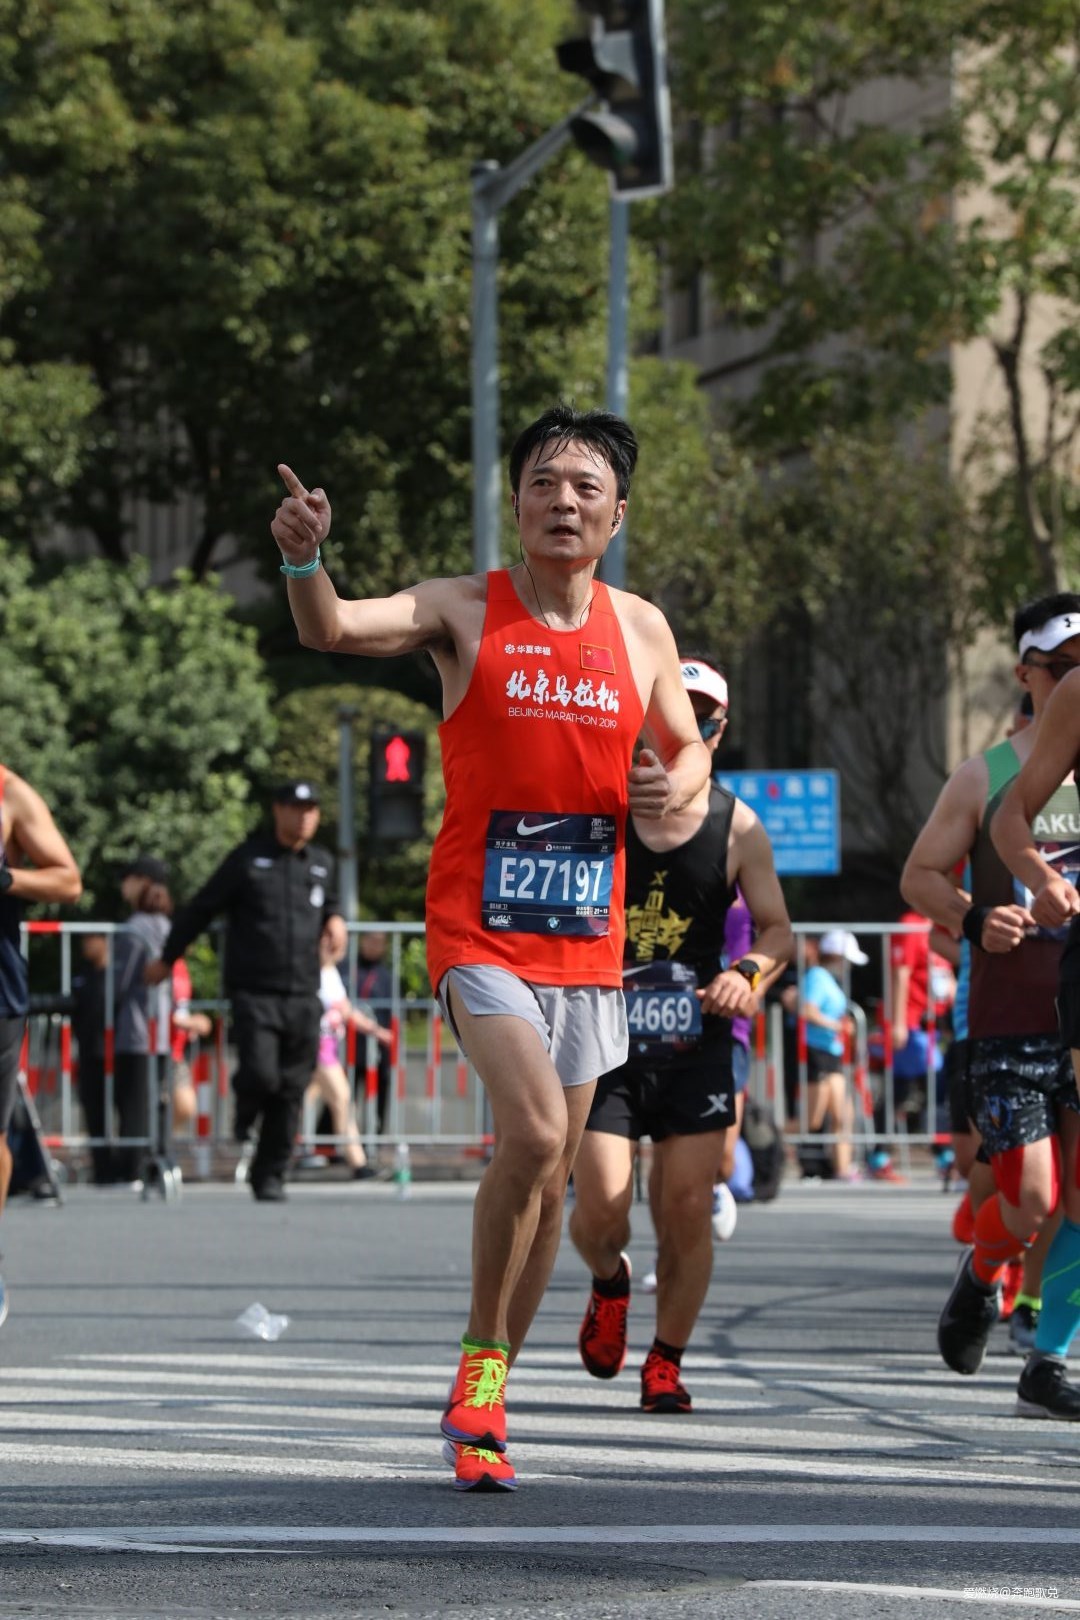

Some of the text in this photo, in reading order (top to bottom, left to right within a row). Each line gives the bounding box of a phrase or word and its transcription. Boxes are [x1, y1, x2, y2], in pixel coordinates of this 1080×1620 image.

[516, 644, 551, 656] 华夏幸福
[506, 669, 619, 714] 北京马拉松
[508, 706, 617, 729] BEIJING MARATHON 2019
[499, 857, 603, 901] E27197
[629, 997, 693, 1031] 4669
